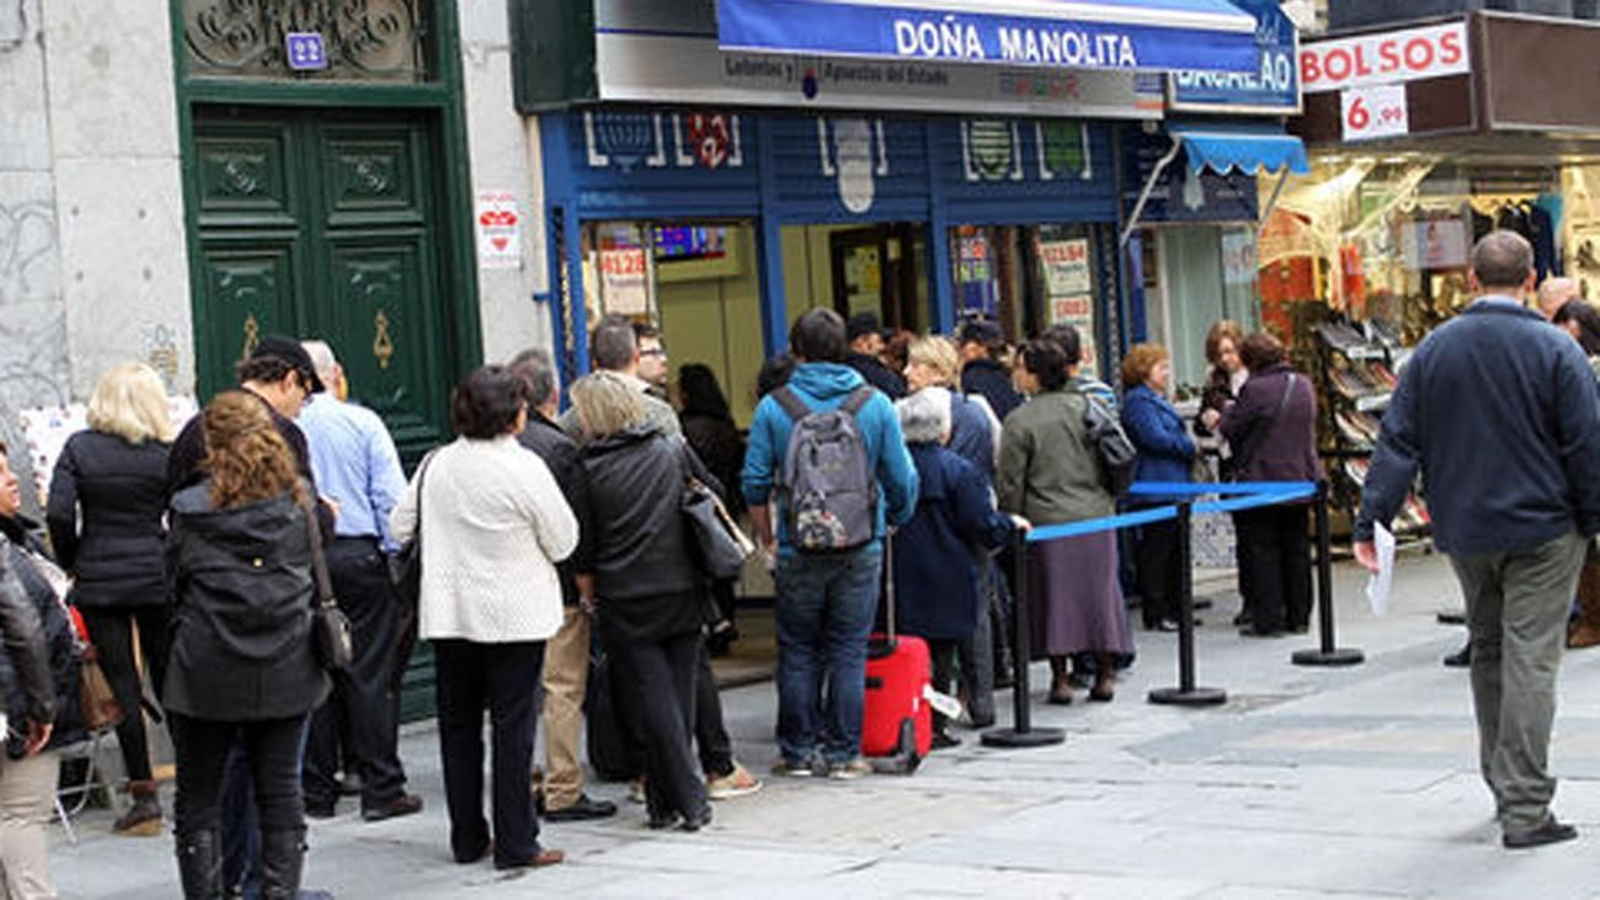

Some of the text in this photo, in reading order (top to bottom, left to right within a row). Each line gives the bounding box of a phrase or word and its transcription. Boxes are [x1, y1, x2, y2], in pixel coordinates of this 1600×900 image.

[894, 16, 1137, 67] DOÑA MANOLITA
[1300, 31, 1462, 84] BOLSOS
[1348, 96, 1370, 130] 6
